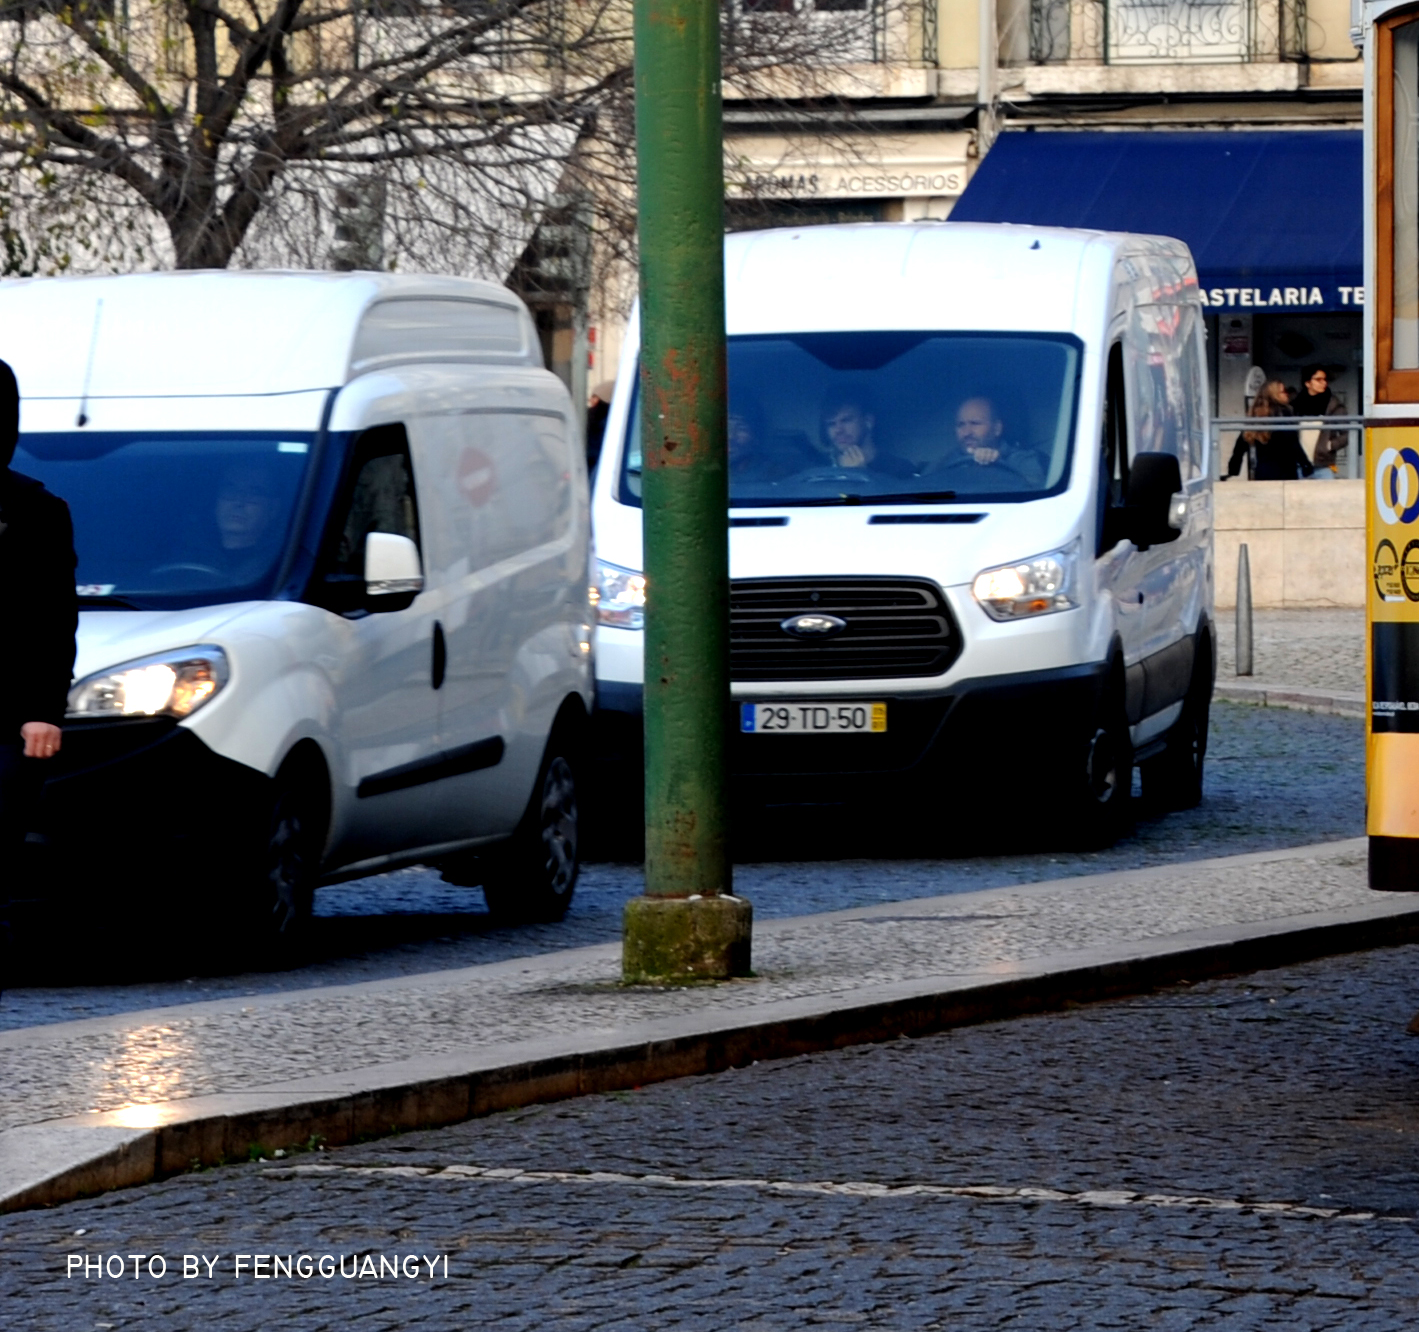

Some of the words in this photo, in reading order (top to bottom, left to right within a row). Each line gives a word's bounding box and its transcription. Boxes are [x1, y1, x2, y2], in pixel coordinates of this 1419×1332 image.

[836, 171, 960, 193] ACESSÓRIOS
[1199, 287, 1324, 307] ASTELARIA
[761, 707, 867, 730] 29-TD-50
